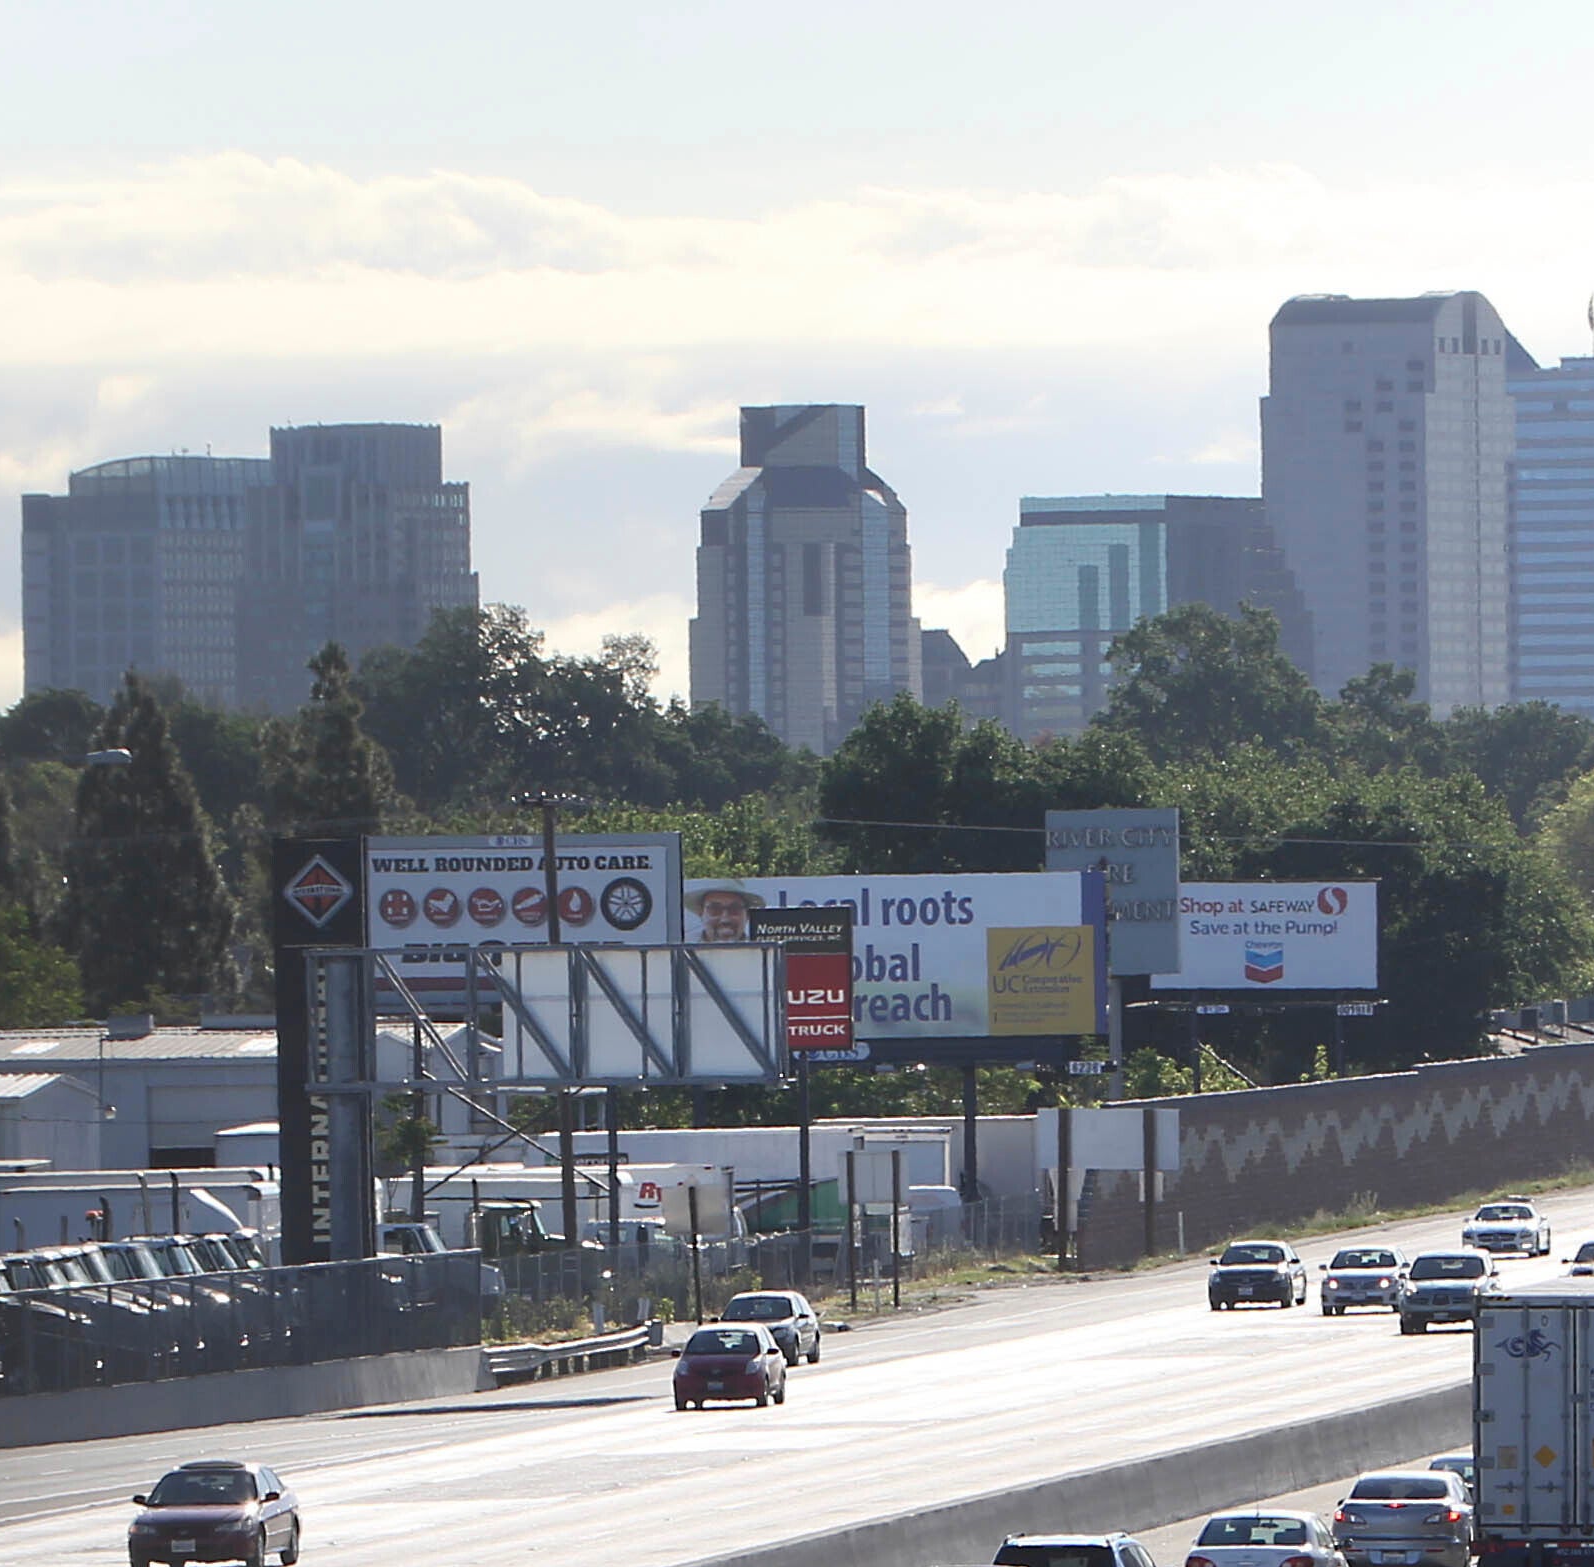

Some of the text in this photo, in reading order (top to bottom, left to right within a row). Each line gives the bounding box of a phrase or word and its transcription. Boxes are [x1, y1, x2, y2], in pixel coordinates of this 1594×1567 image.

[1046, 828, 1173, 848] RIVER CITY
[371, 858, 429, 873] WELL
[434, 856, 533, 872] ROUNDED
[595, 855, 653, 870] CARE.
[882, 890, 974, 926] roots
[1180, 897, 1315, 916] Shop at SAFEWAY
[757, 922, 843, 934] NORTH VALLEY
[1190, 920, 1338, 936] Save at the Pump!
[993, 975, 1022, 993] UC
[787, 989, 844, 1005] UZU
[789, 1014, 845, 1036] TRUCK
